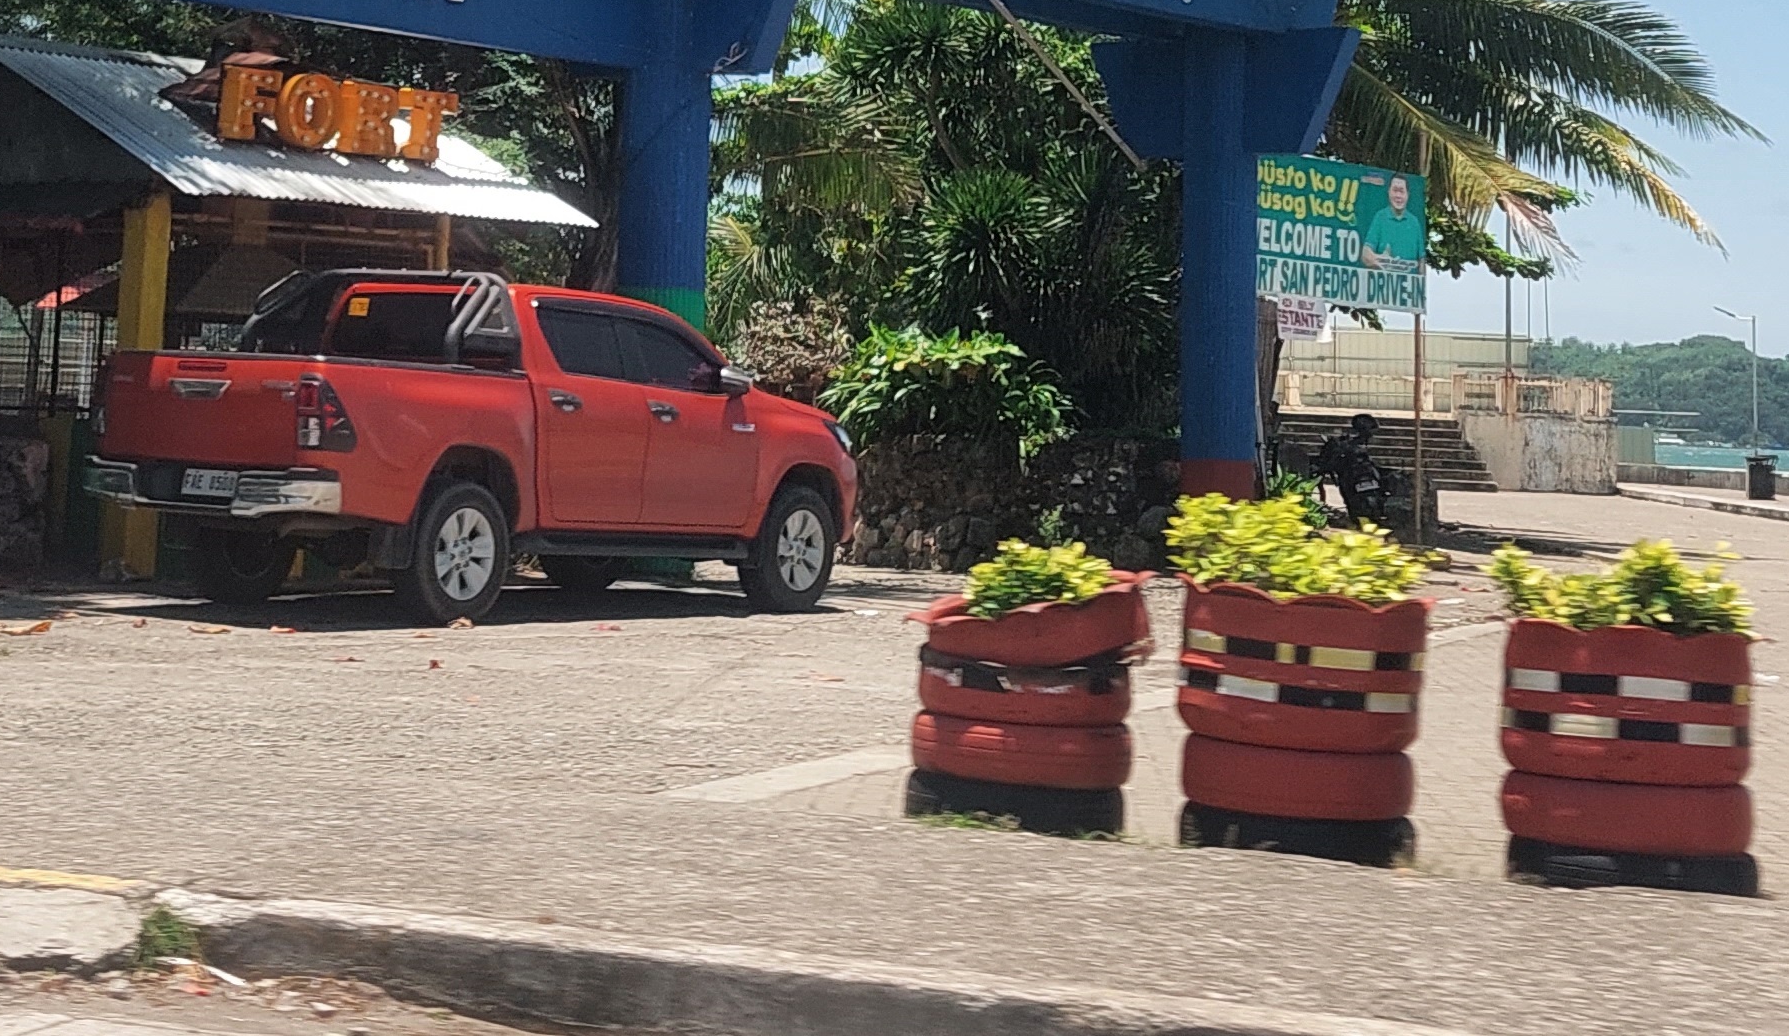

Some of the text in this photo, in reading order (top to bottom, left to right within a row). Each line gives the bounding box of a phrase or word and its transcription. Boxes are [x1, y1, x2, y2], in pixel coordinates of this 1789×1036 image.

[218, 65, 460, 160] FORT
[1309, 168, 1336, 193] ko
[1257, 218, 1360, 263] ELCOME TO
[1258, 257, 1426, 309] RT SAN PEDRO DRIVE-IN
